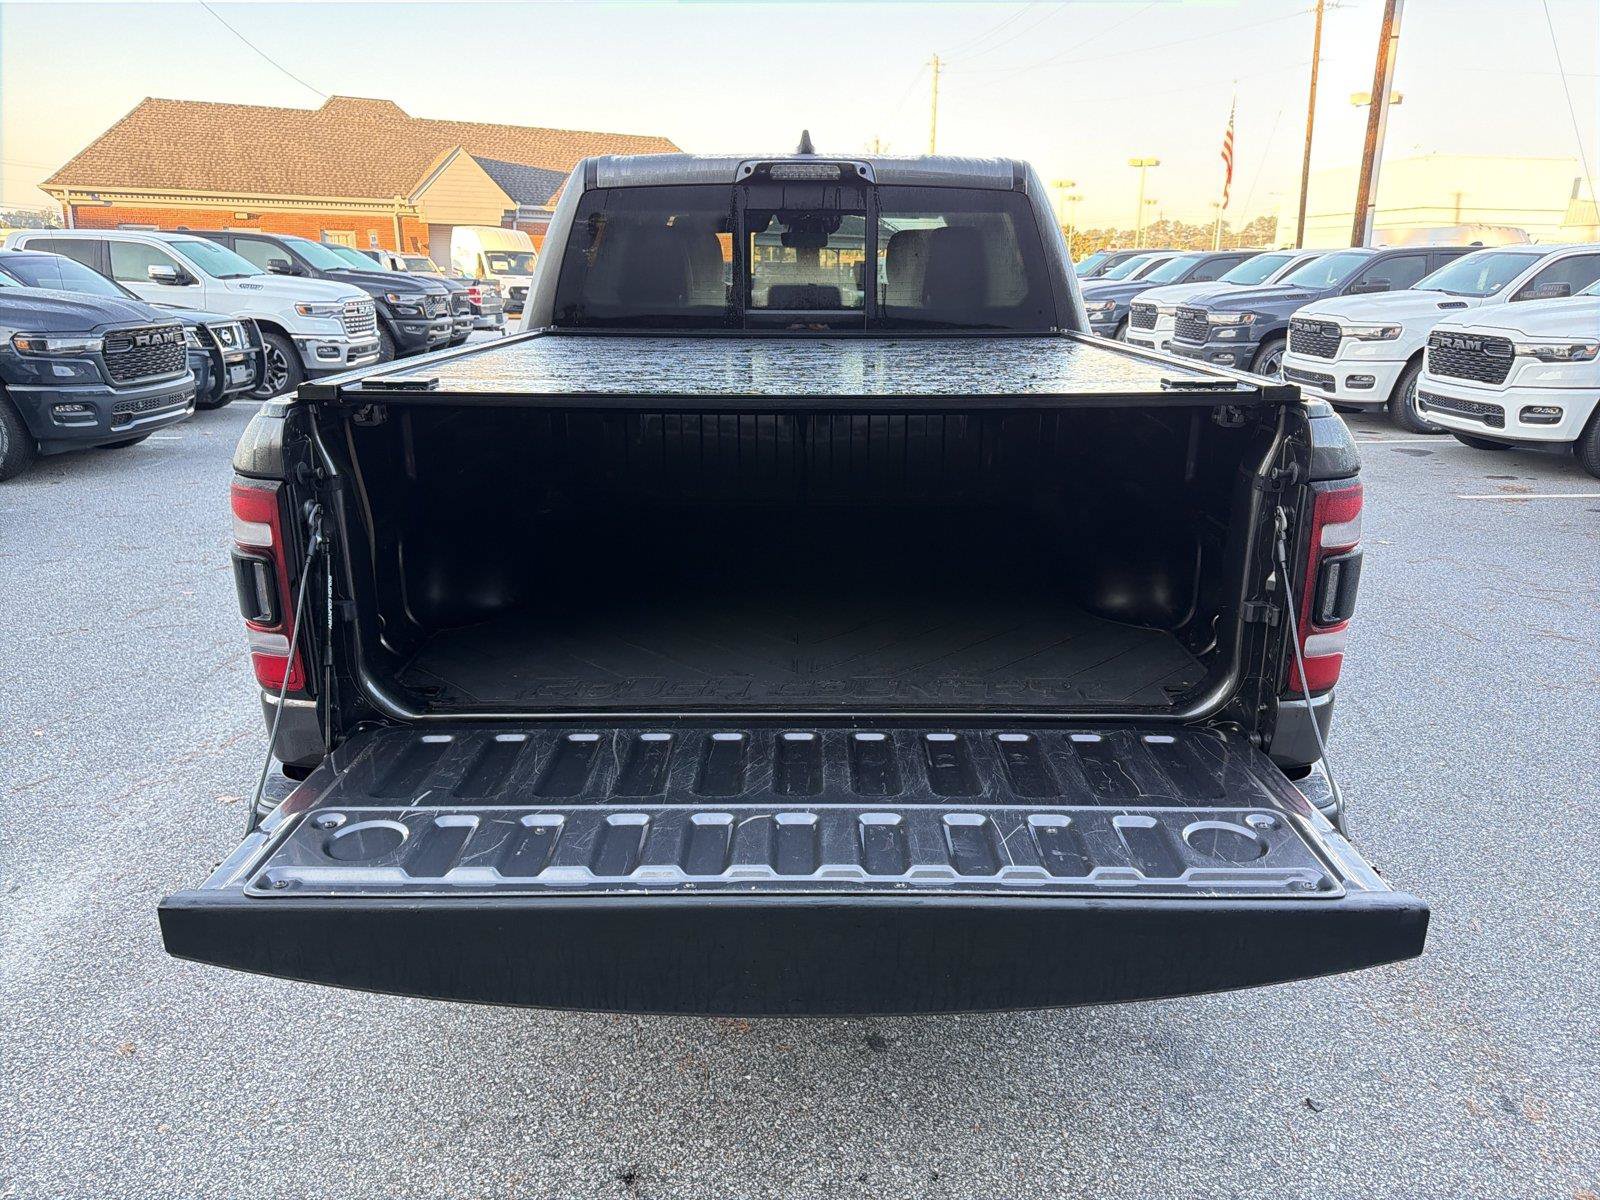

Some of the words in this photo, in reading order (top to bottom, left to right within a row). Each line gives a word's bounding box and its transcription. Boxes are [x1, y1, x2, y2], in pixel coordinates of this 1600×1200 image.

[1295, 322, 1322, 334] RAM
[135, 332, 175, 346] RAM
[1440, 337, 1482, 351] RAM
